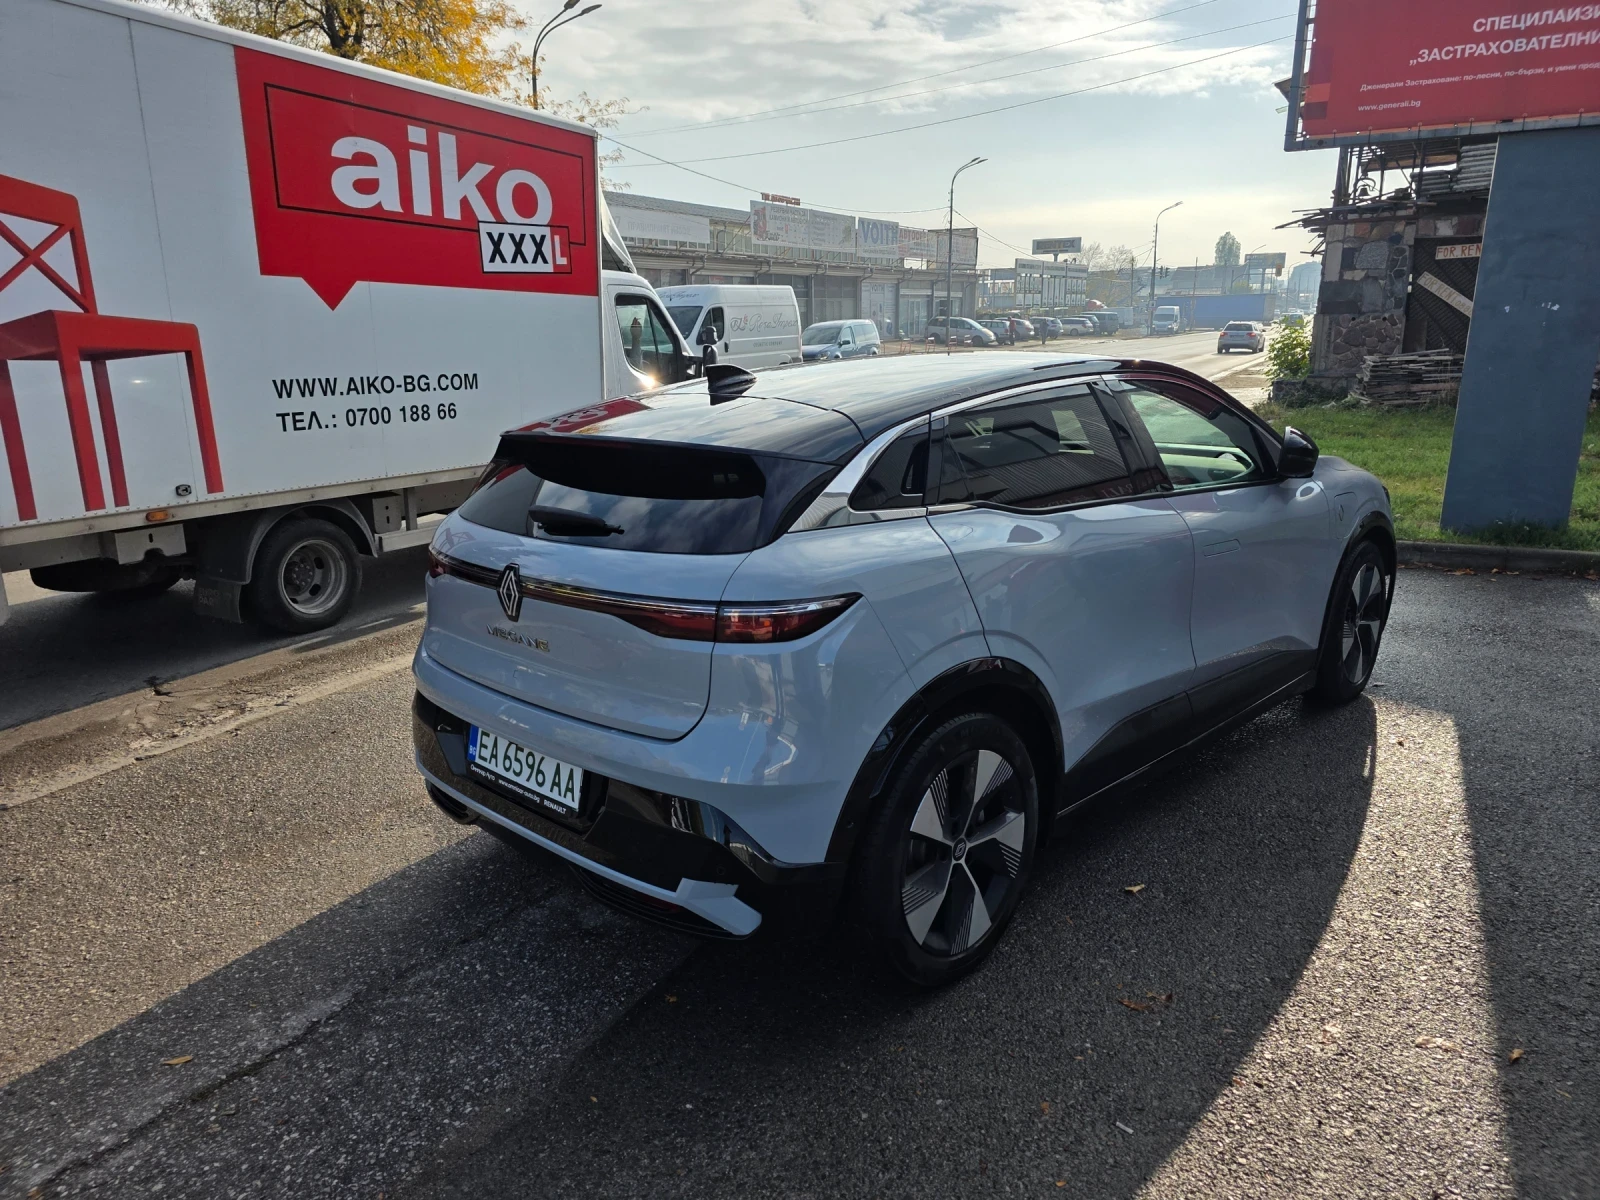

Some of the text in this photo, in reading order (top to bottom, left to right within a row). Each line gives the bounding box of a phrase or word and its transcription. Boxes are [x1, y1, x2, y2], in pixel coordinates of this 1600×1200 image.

[1360, 82, 1404, 92] Дженерали
[1405, 75, 1462, 87] Застраховане:
[1463, 71, 1503, 81] по-лесни,
[1504, 67, 1546, 77] по-бързи,
[1554, 64, 1577, 73] умни
[1358, 100, 1421, 111] www.generali.bg
[331, 125, 553, 224] aiko
[861, 220, 899, 245] VOITH
[272, 373, 479, 399] WWW.AIKO-BG.COM
[345, 406, 391, 427] 0700
[399, 404, 431, 423] 188
[437, 402, 457, 420] 66
[486, 624, 550, 652] MEGANE
[469, 744, 477, 756] BG
[478, 730, 575, 802] EA 6596 AA
[543, 798, 567, 815] RENAULT
